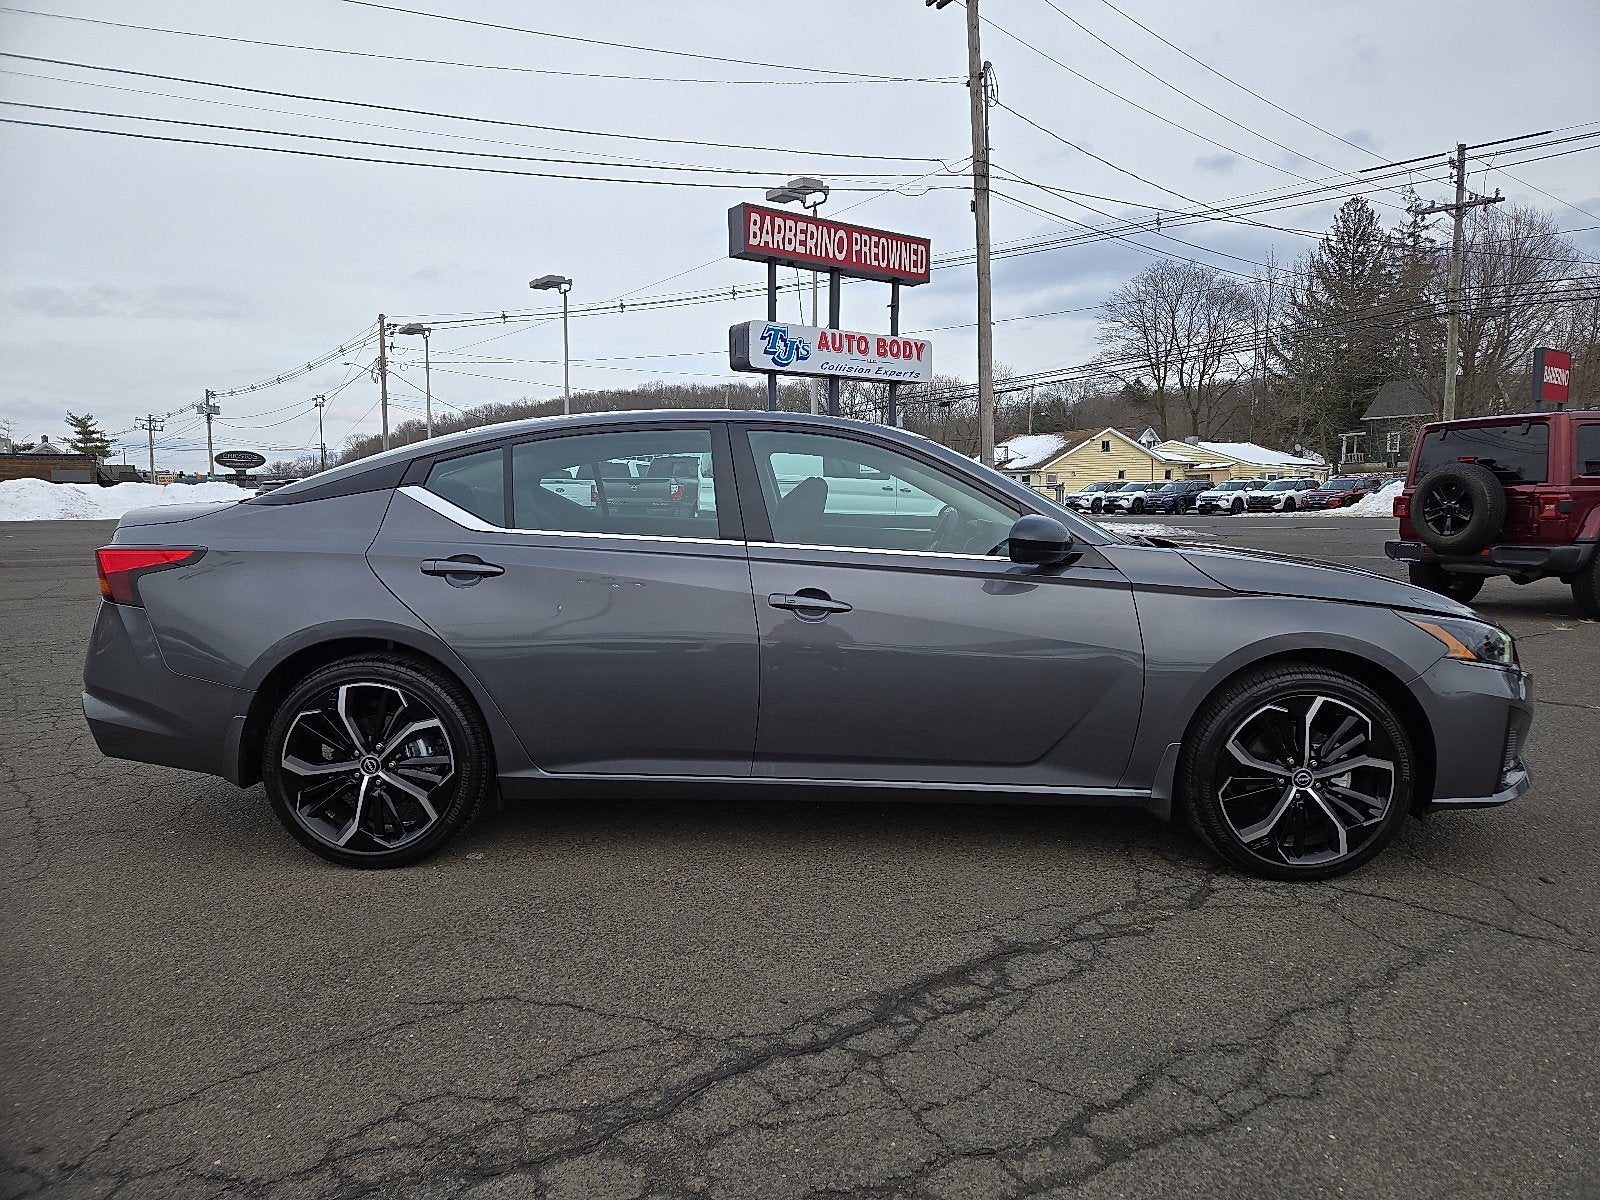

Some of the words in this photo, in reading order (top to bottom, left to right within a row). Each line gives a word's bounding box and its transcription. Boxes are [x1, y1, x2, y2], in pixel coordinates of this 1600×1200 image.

[749, 212, 848, 261] BARBERINO
[852, 231, 927, 274] PREOWNED
[817, 331, 869, 356] AUTO
[876, 337, 925, 361] BODY
[820, 361, 872, 374] Collision
[874, 366, 921, 379] Experts
[1382, 717, 1410, 783] BRIDGESTONE
[445, 762, 471, 826] BRIDGESTONE
